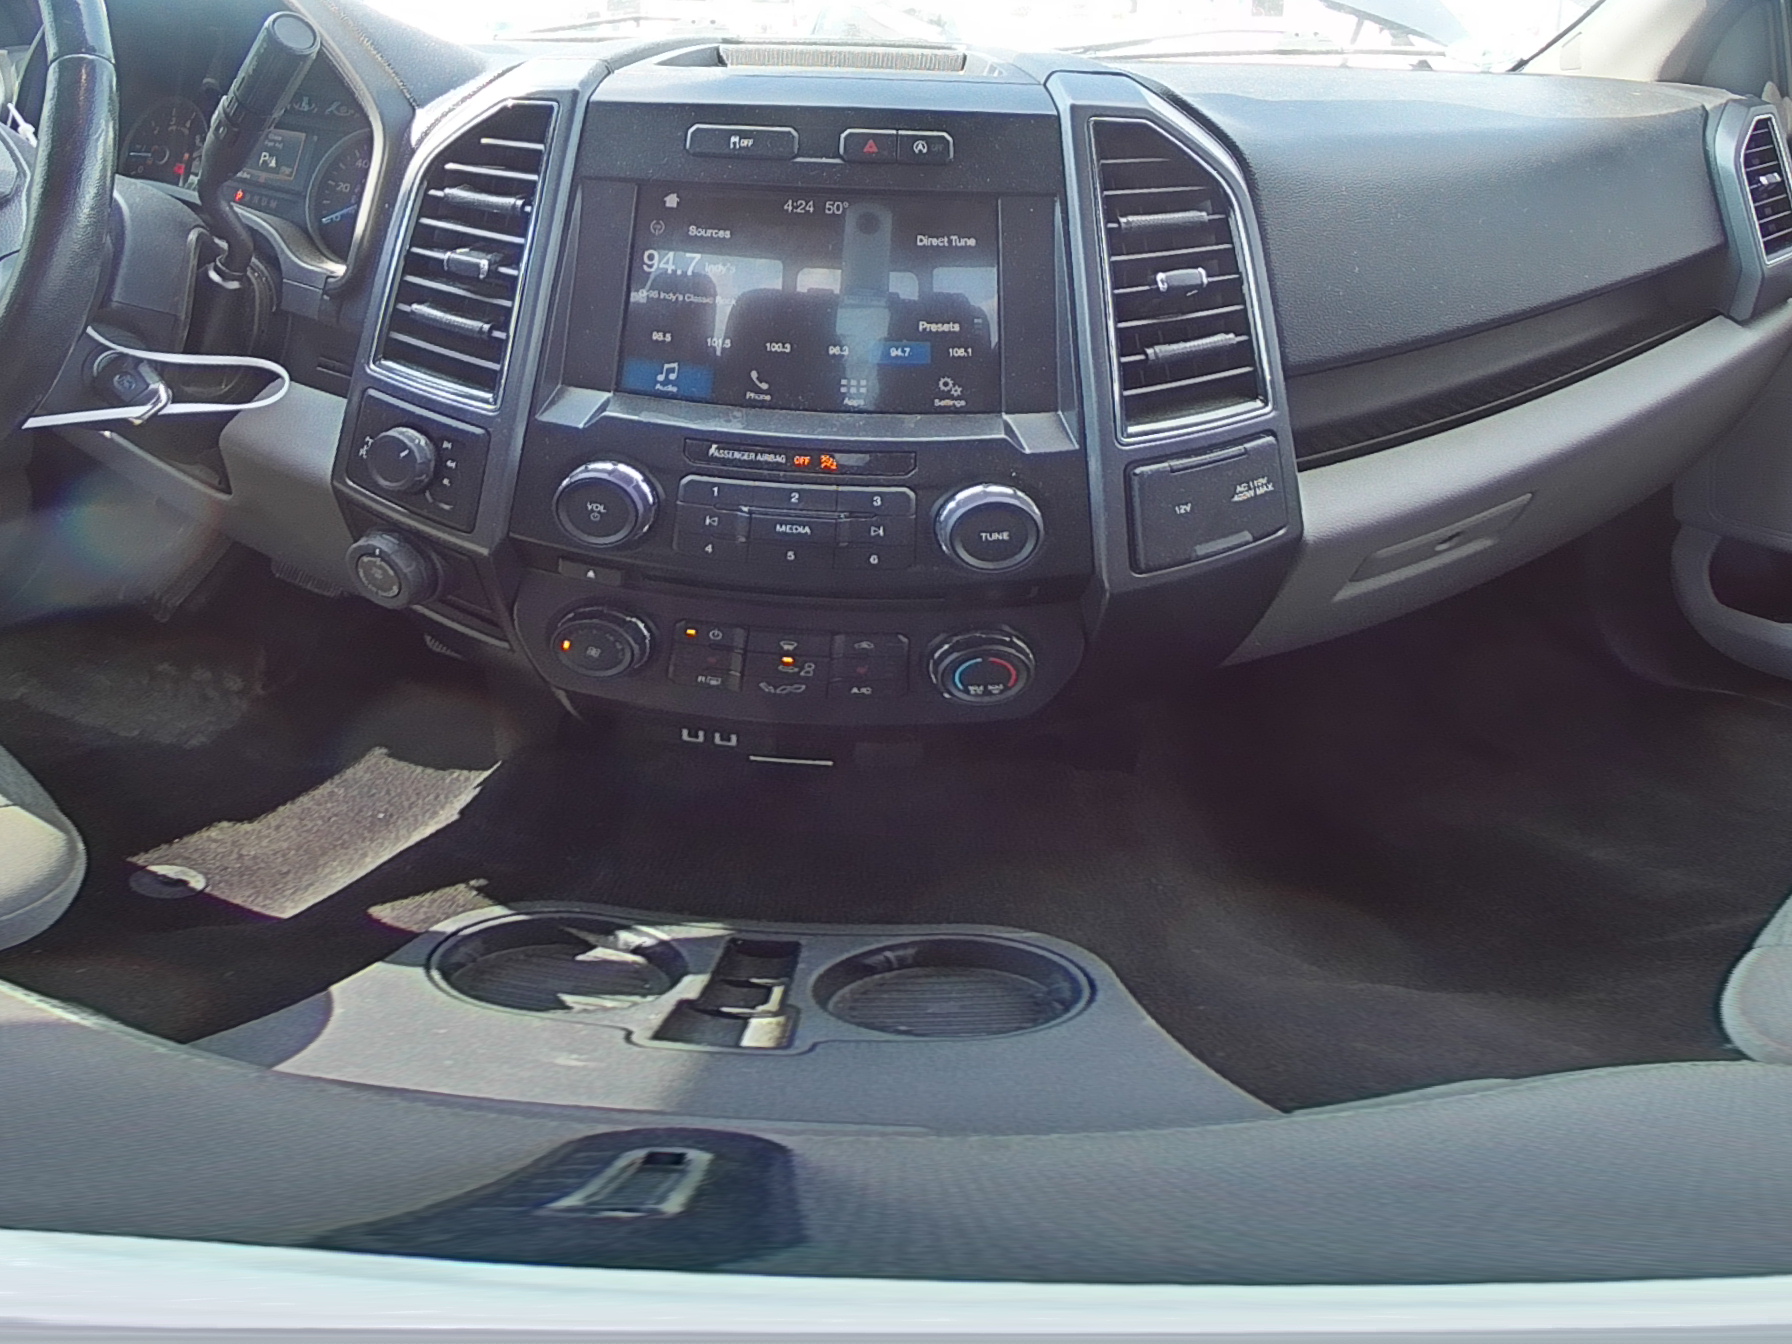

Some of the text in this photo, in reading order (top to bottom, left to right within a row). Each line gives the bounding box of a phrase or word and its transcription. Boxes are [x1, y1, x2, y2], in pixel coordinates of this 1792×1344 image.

[336, 182, 351, 193] 20
[783, 199, 849, 215] 4:24 50°
[688, 225, 731, 239] Sources
[916, 235, 977, 247] Direct Tune
[642, 249, 702, 276] 94.7
[659, 291, 683, 302] Indy's
[918, 321, 961, 332] Presets
[745, 391, 772, 401] Phone
[708, 444, 811, 466] PASSENGER AIRBAG OFF
[712, 486, 719, 497] 1
[790, 492, 800, 503] 2
[872, 495, 882, 507] 3
[586, 502, 607, 513] VOL
[1174, 502, 1192, 515] 12V
[775, 523, 812, 535] MEDIA
[979, 531, 1010, 542] TUNE
[704, 544, 713, 554] 4
[786, 551, 795, 561] 5
[869, 554, 879, 565] 6
[850, 686, 872, 695] A/C
